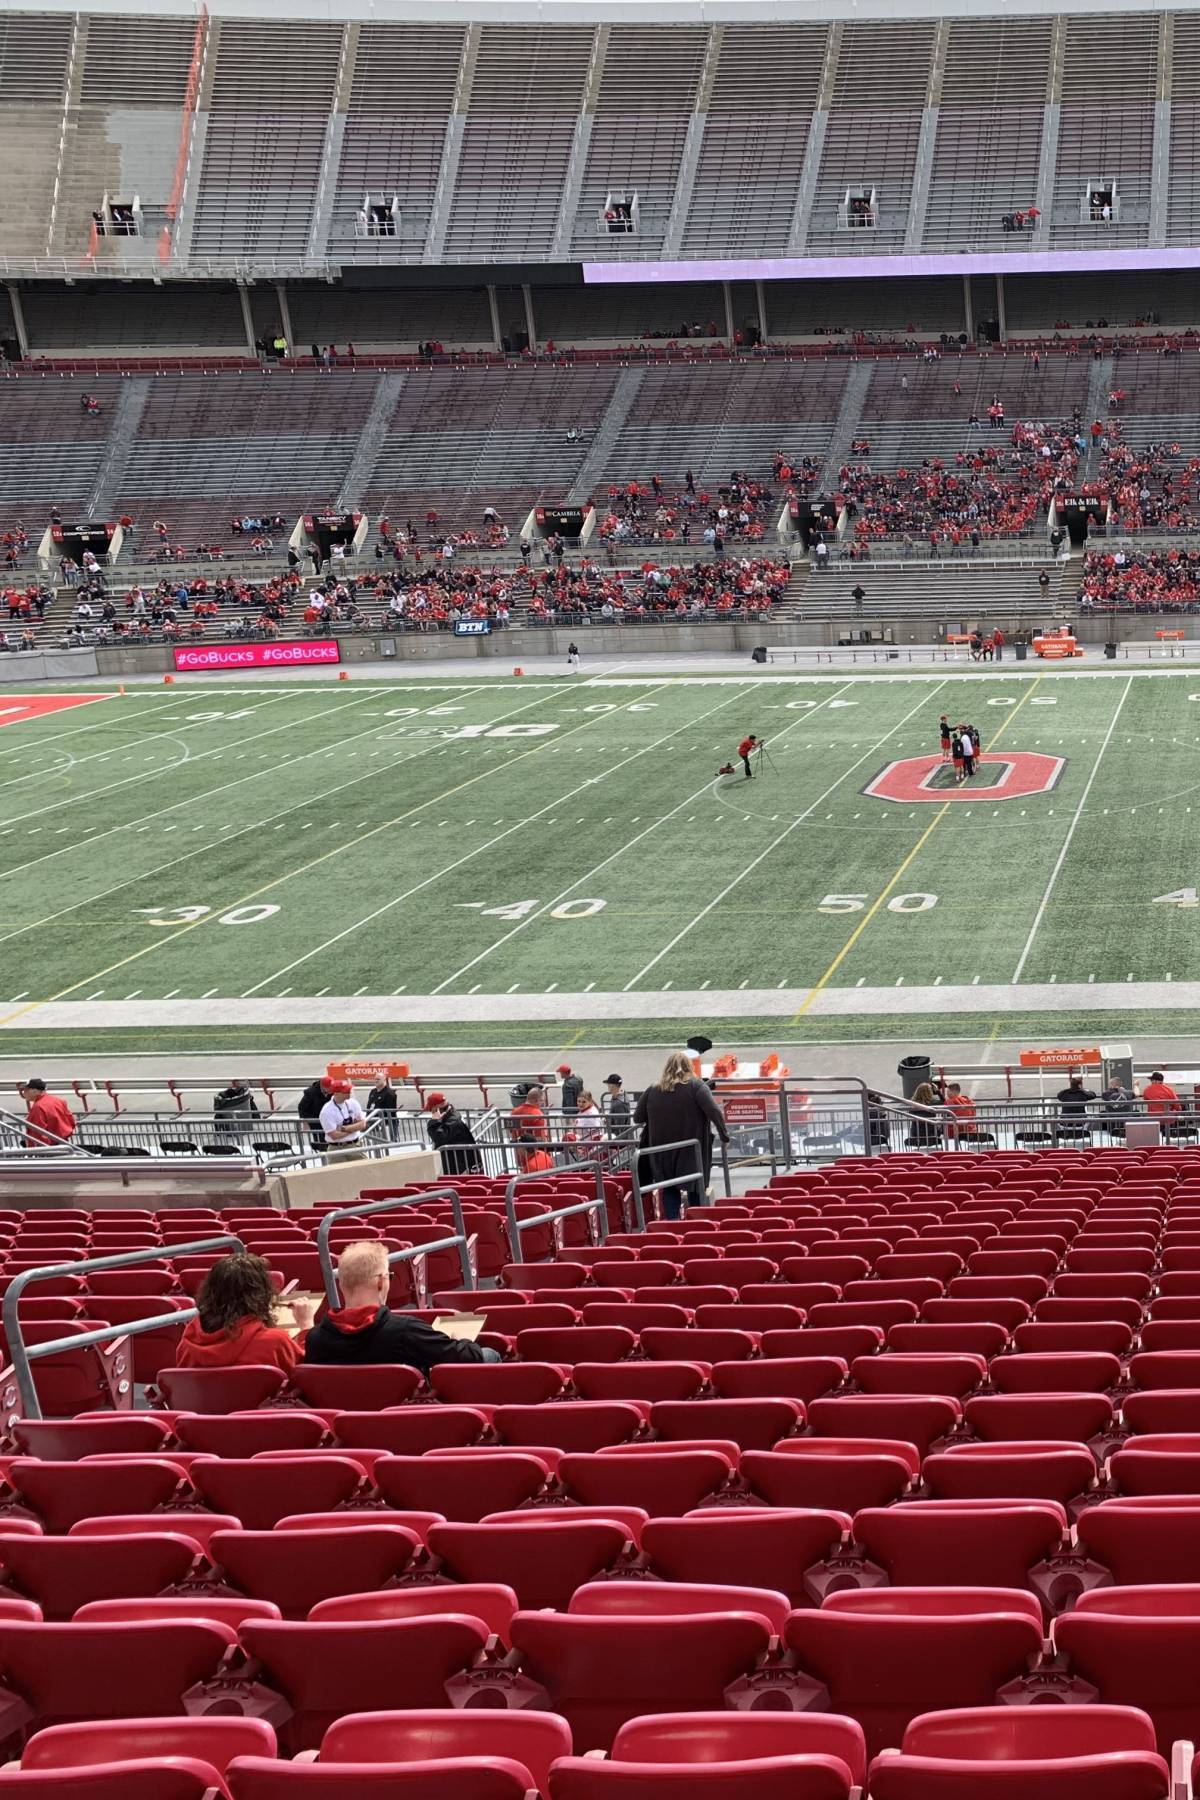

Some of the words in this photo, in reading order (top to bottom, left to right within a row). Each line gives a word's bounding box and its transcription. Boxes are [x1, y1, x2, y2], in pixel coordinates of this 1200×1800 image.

[552, 510, 581, 518] CAMBRIA
[458, 622, 484, 632] BTN
[987, 696, 1058, 706] 50
[817, 892, 940, 914] 50
[479, 898, 608, 920] 40
[149, 903, 281, 926] 30
[1039, 1054, 1084, 1063] GATORADE
